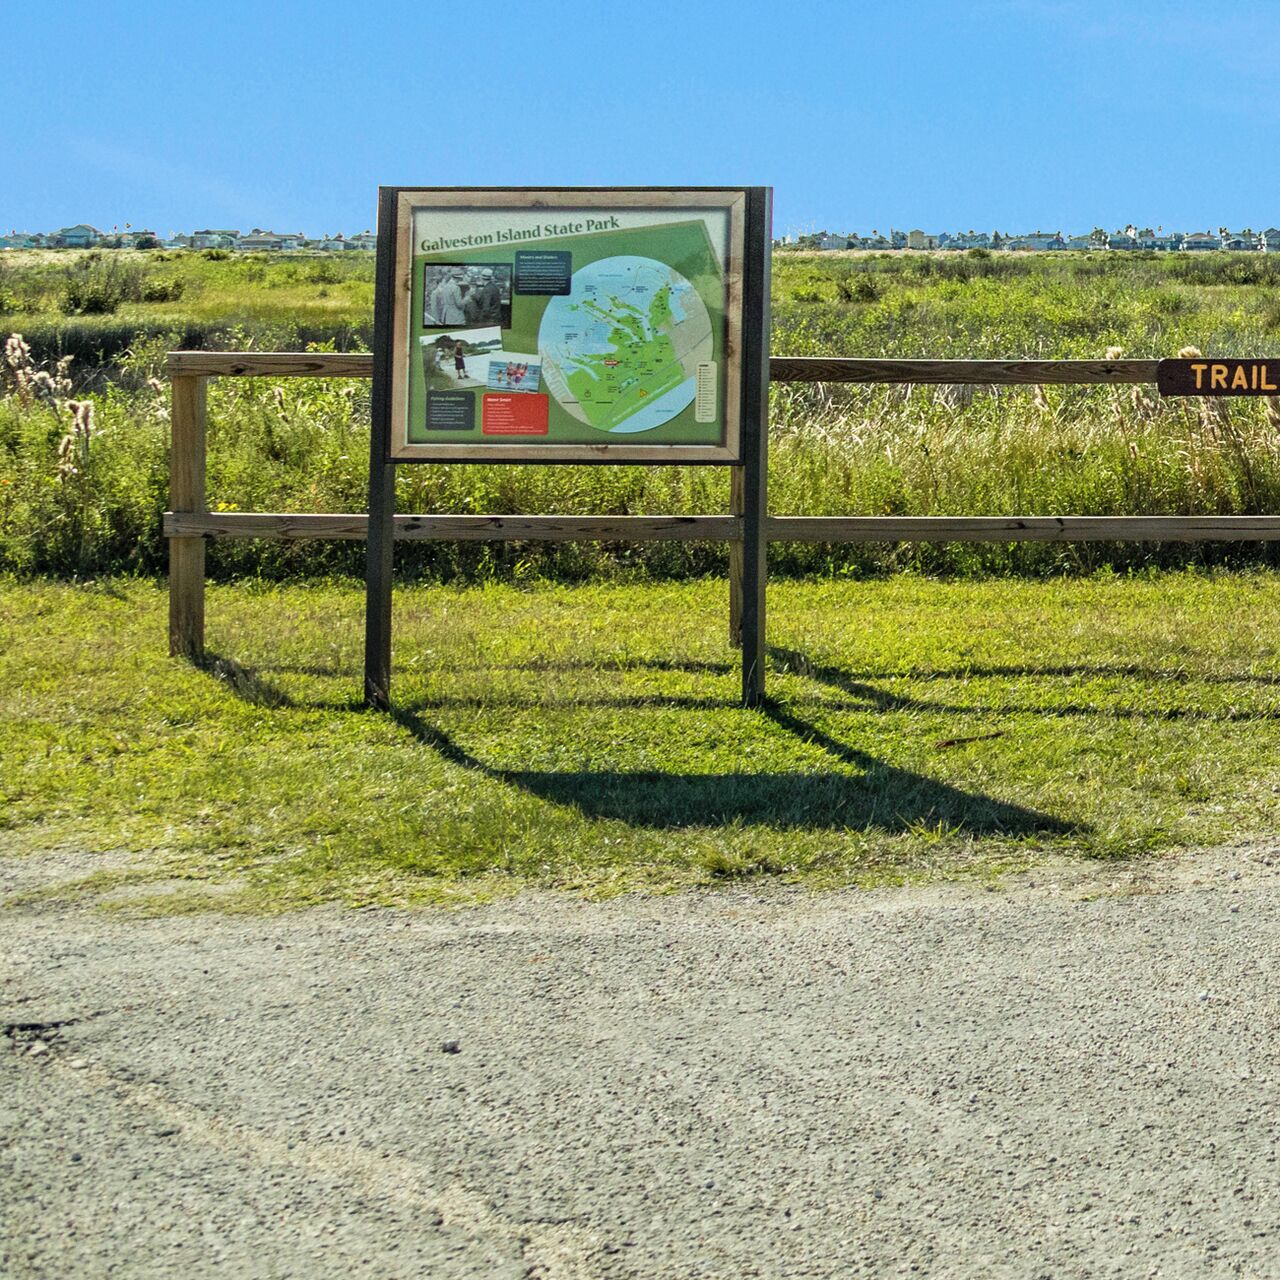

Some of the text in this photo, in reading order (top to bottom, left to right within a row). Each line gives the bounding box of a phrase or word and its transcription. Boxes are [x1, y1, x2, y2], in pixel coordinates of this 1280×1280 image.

[420, 215, 620, 252] Galveston Island State Park
[1191, 364, 1277, 390] TRAIL
